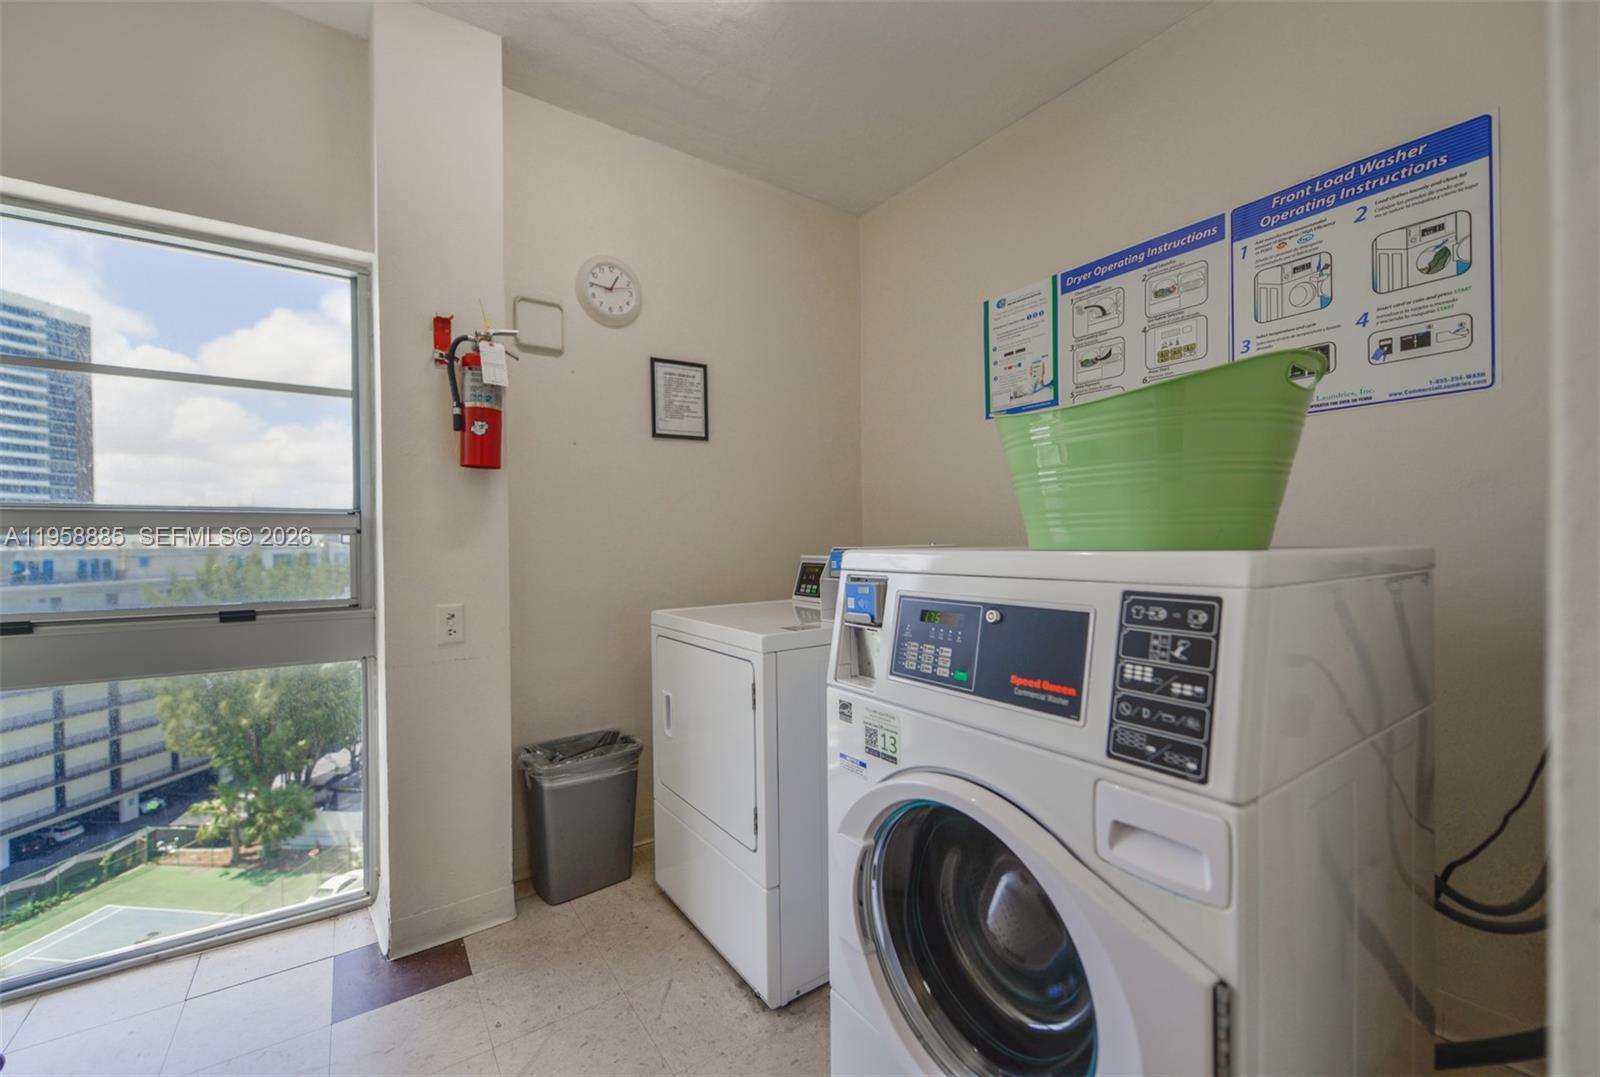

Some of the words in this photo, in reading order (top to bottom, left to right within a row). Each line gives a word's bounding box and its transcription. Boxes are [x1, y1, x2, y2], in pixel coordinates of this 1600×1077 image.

[1271, 183, 1313, 209] Front
[1315, 167, 1354, 192] Load
[1358, 143, 1427, 177] Washer
[1259, 194, 1336, 229] Operating
[1340, 153, 1448, 200] Instructions
[1353, 205, 1368, 223] 2
[1066, 271, 1093, 288] Dryer
[1094, 249, 1145, 278] Operating
[1147, 225, 1218, 258] Instructions
[1241, 246, 1248, 260] 1
[1142, 274, 1147, 282] 2
[1355, 312, 1370, 328] 4
[1240, 340, 1251, 354] 3
[1142, 376, 1148, 384] 6
[1070, 391, 1075, 399] 5
[1009, 674, 1041, 689] Speed
[1042, 680, 1077, 697] Queen
[881, 733, 897, 754] 13
